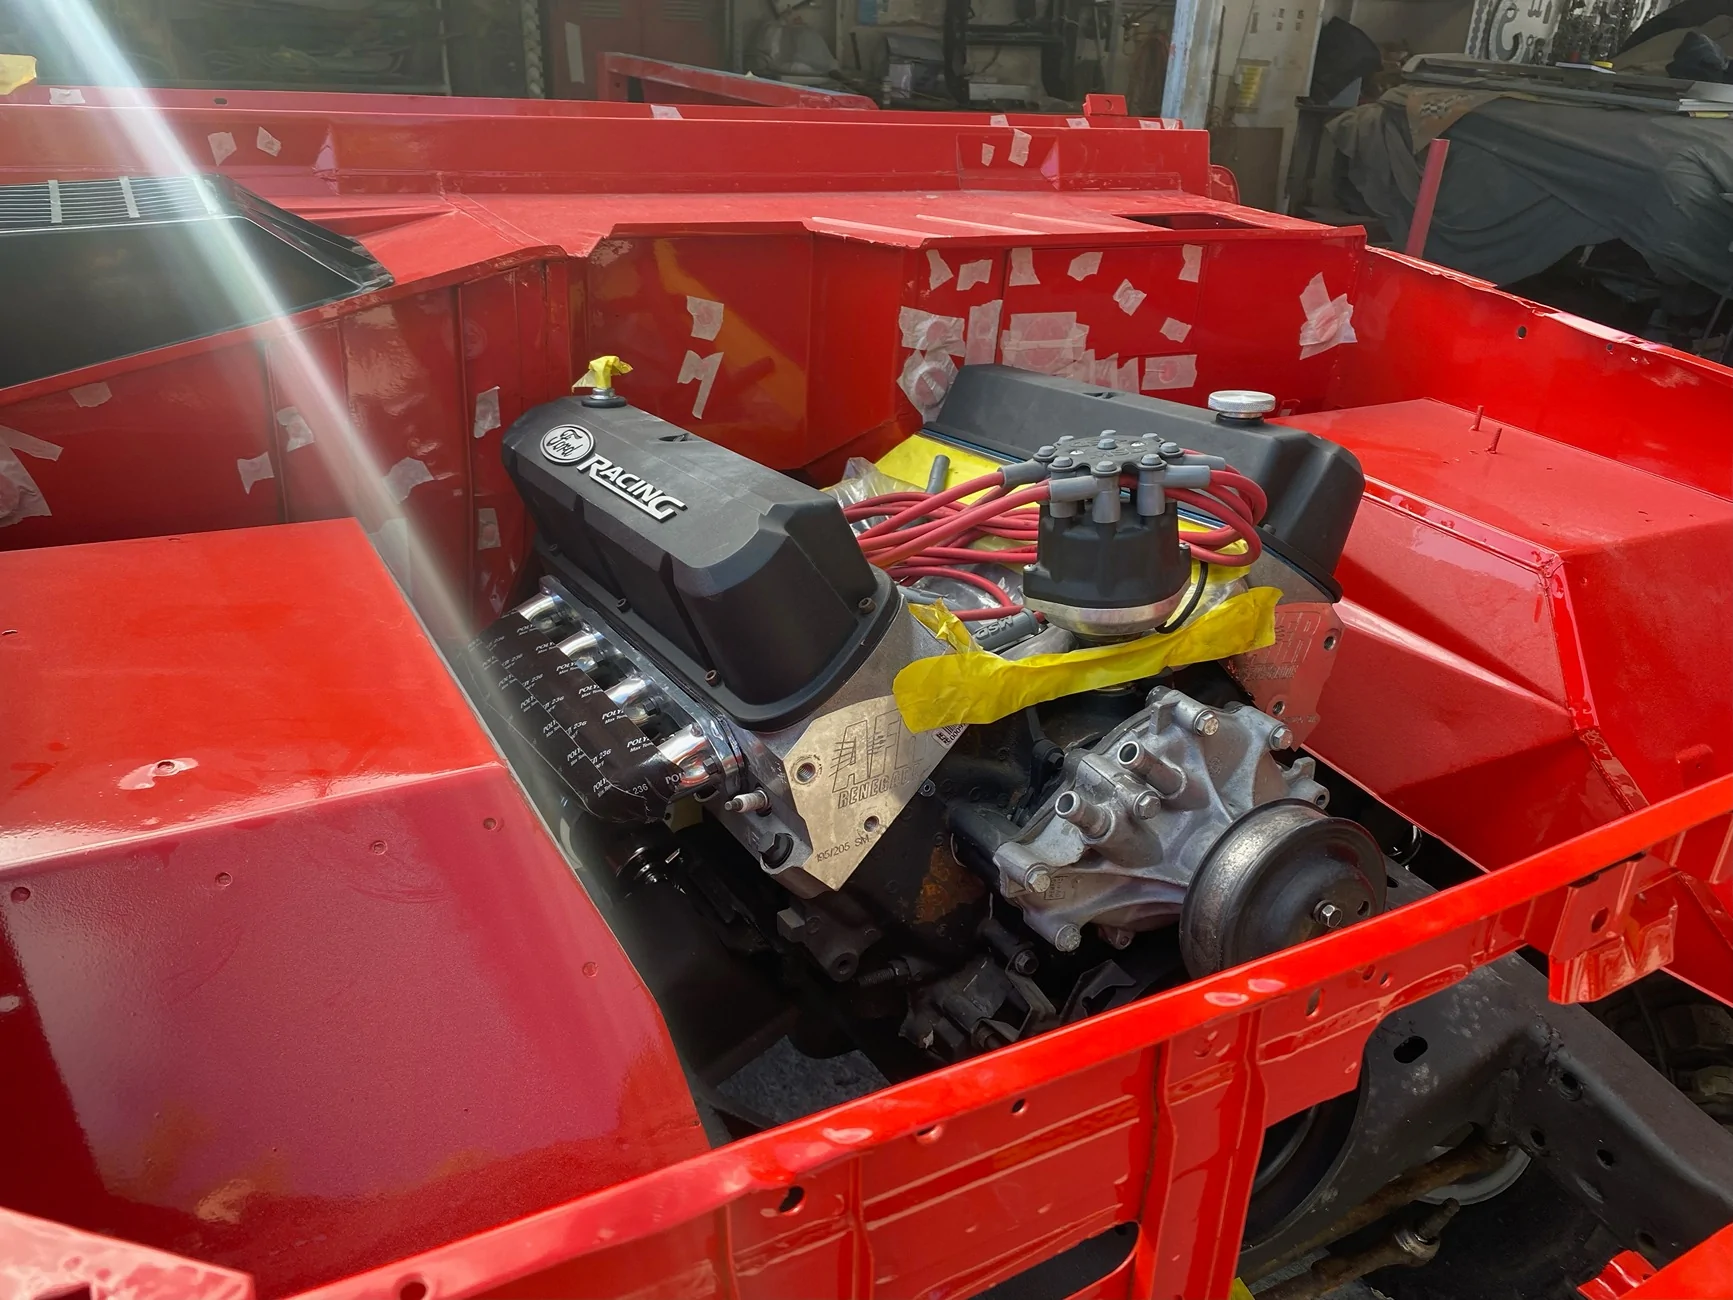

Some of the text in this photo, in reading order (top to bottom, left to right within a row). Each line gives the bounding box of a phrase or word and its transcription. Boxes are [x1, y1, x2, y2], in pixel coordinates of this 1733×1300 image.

[576, 452, 686, 520] RACING
[578, 684, 600, 695] POLY
[602, 709, 624, 720] POLY
[626, 736, 650, 748] POLY
[598, 748, 612, 758] 236
[632, 783, 649, 795] 236
[814, 841, 851, 863] 195/205
